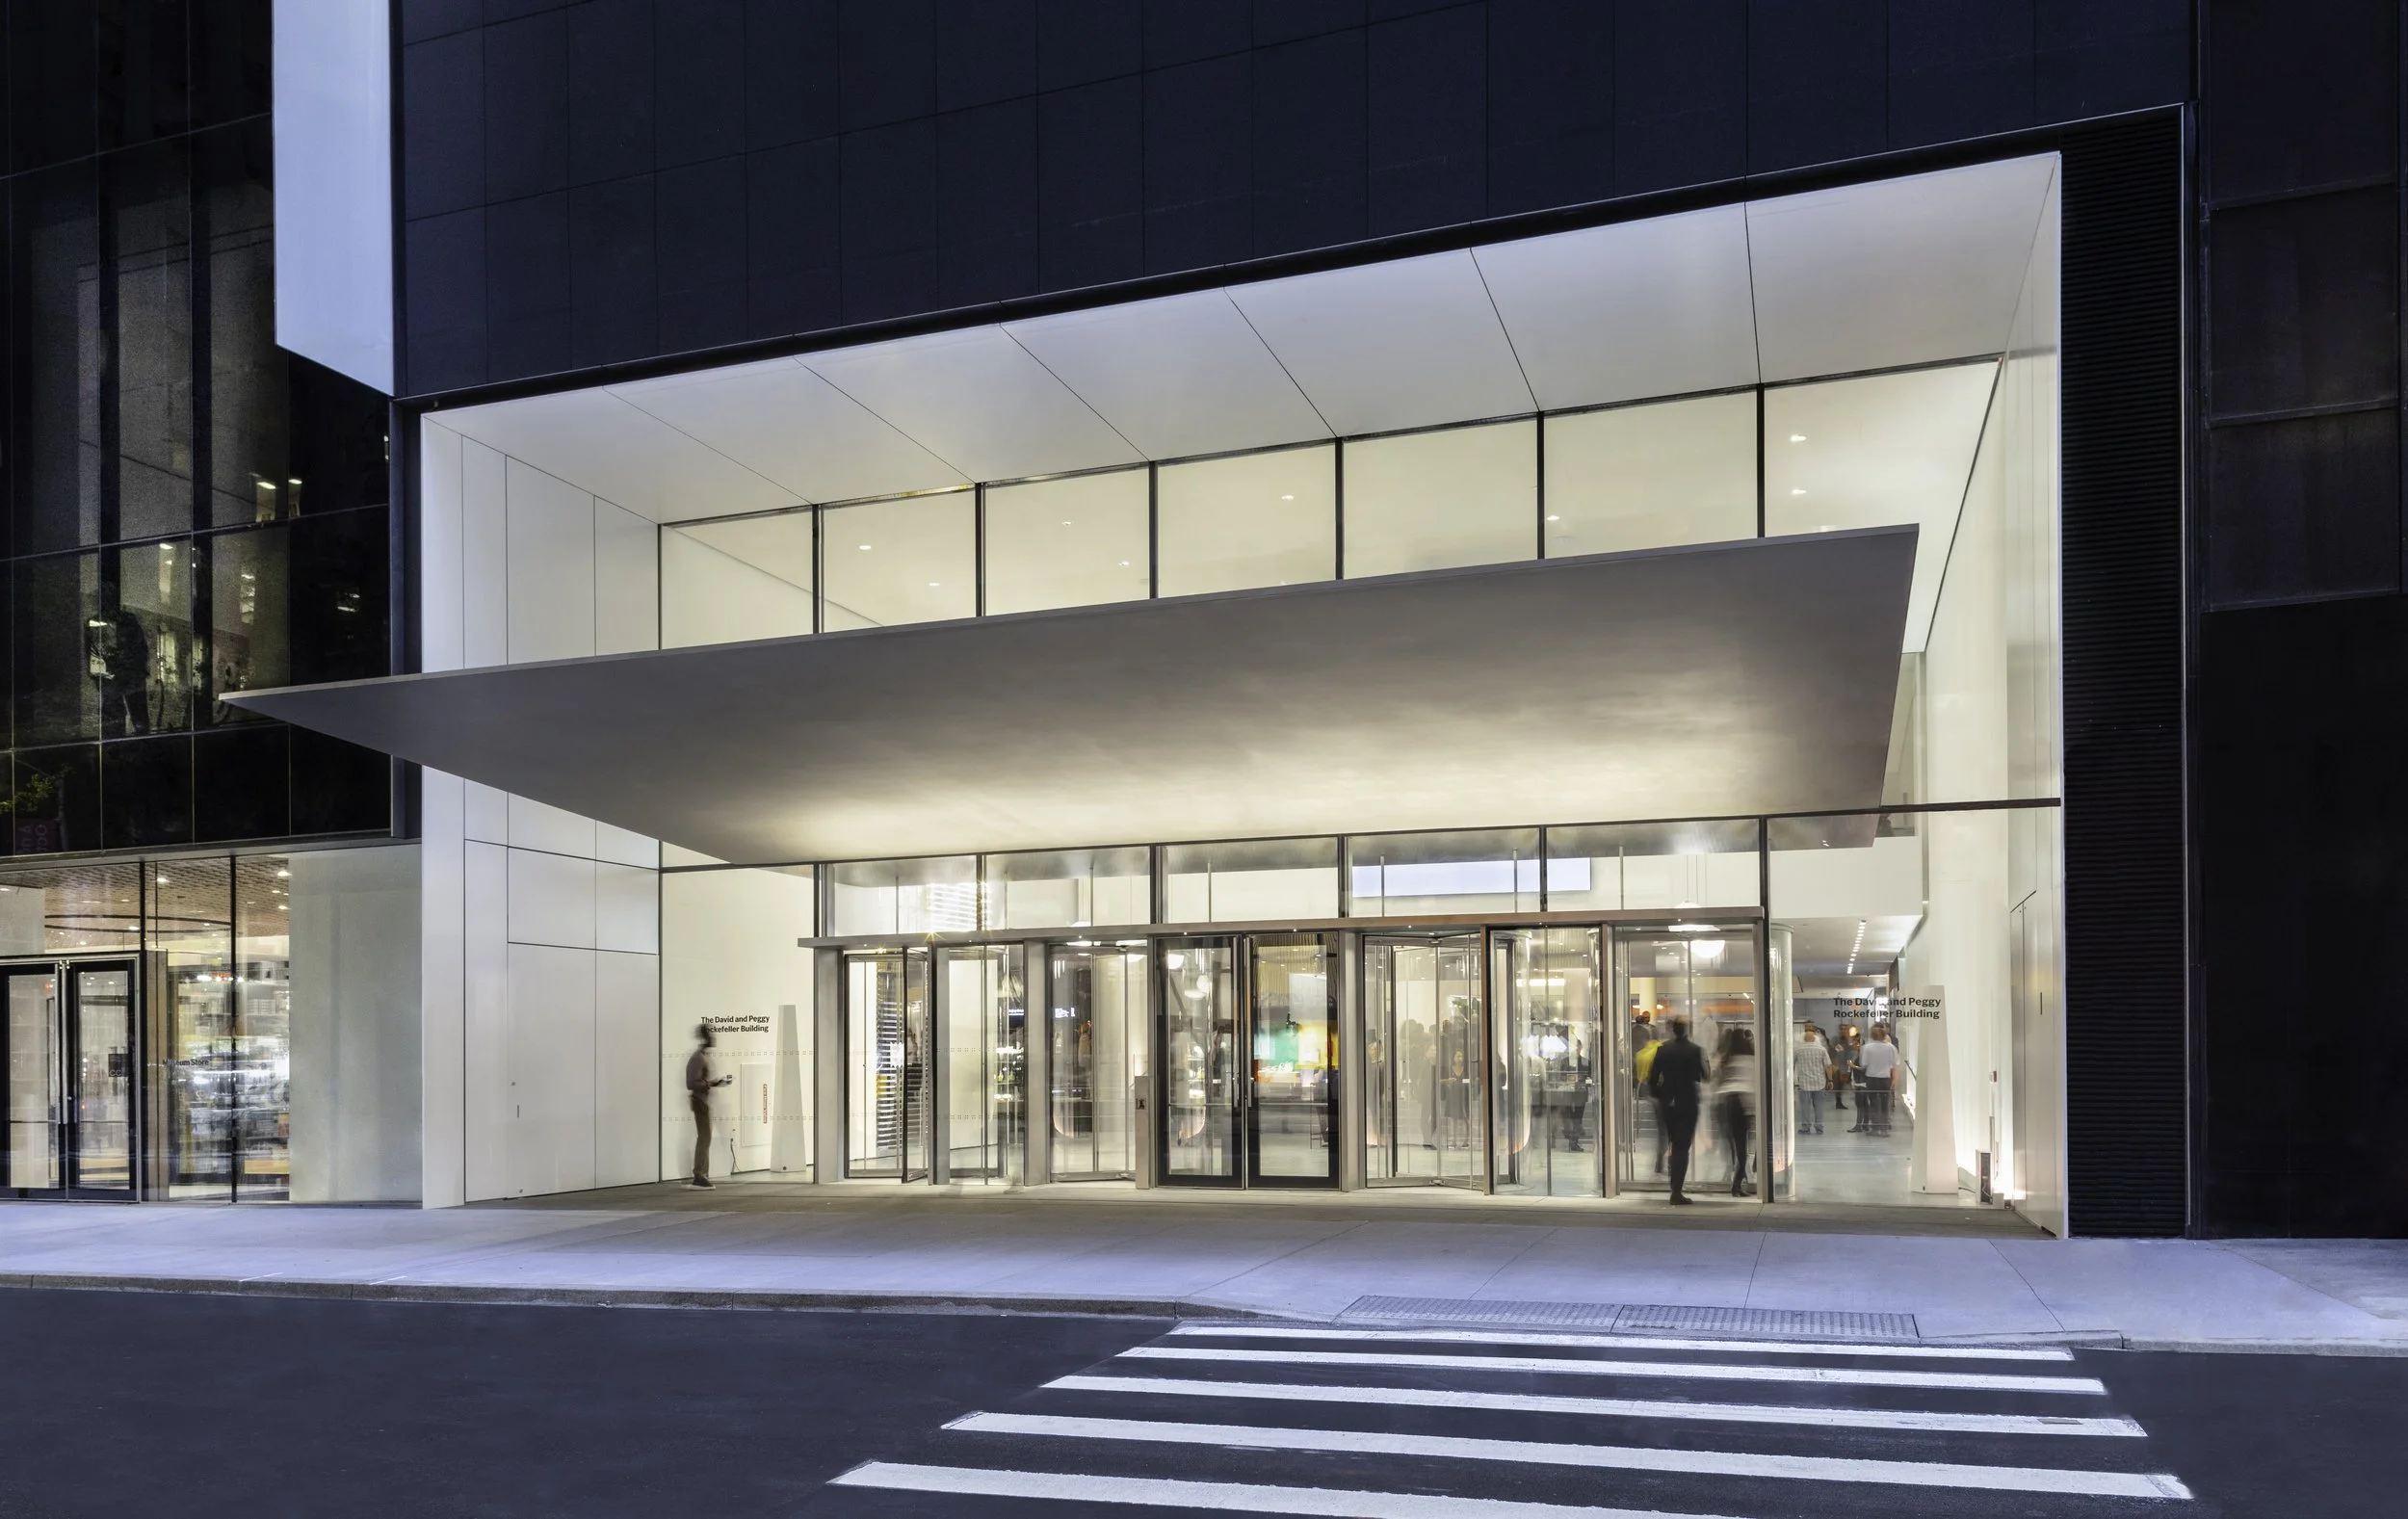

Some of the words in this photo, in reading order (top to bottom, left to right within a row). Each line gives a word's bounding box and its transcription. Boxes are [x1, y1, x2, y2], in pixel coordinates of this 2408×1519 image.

[1834, 997, 1852, 1007] The
[1855, 997, 1886, 1007] Dav
[1887, 997, 1906, 1007] and
[1908, 997, 1941, 1008] Peggy
[1896, 1008, 1940, 1019] Building
